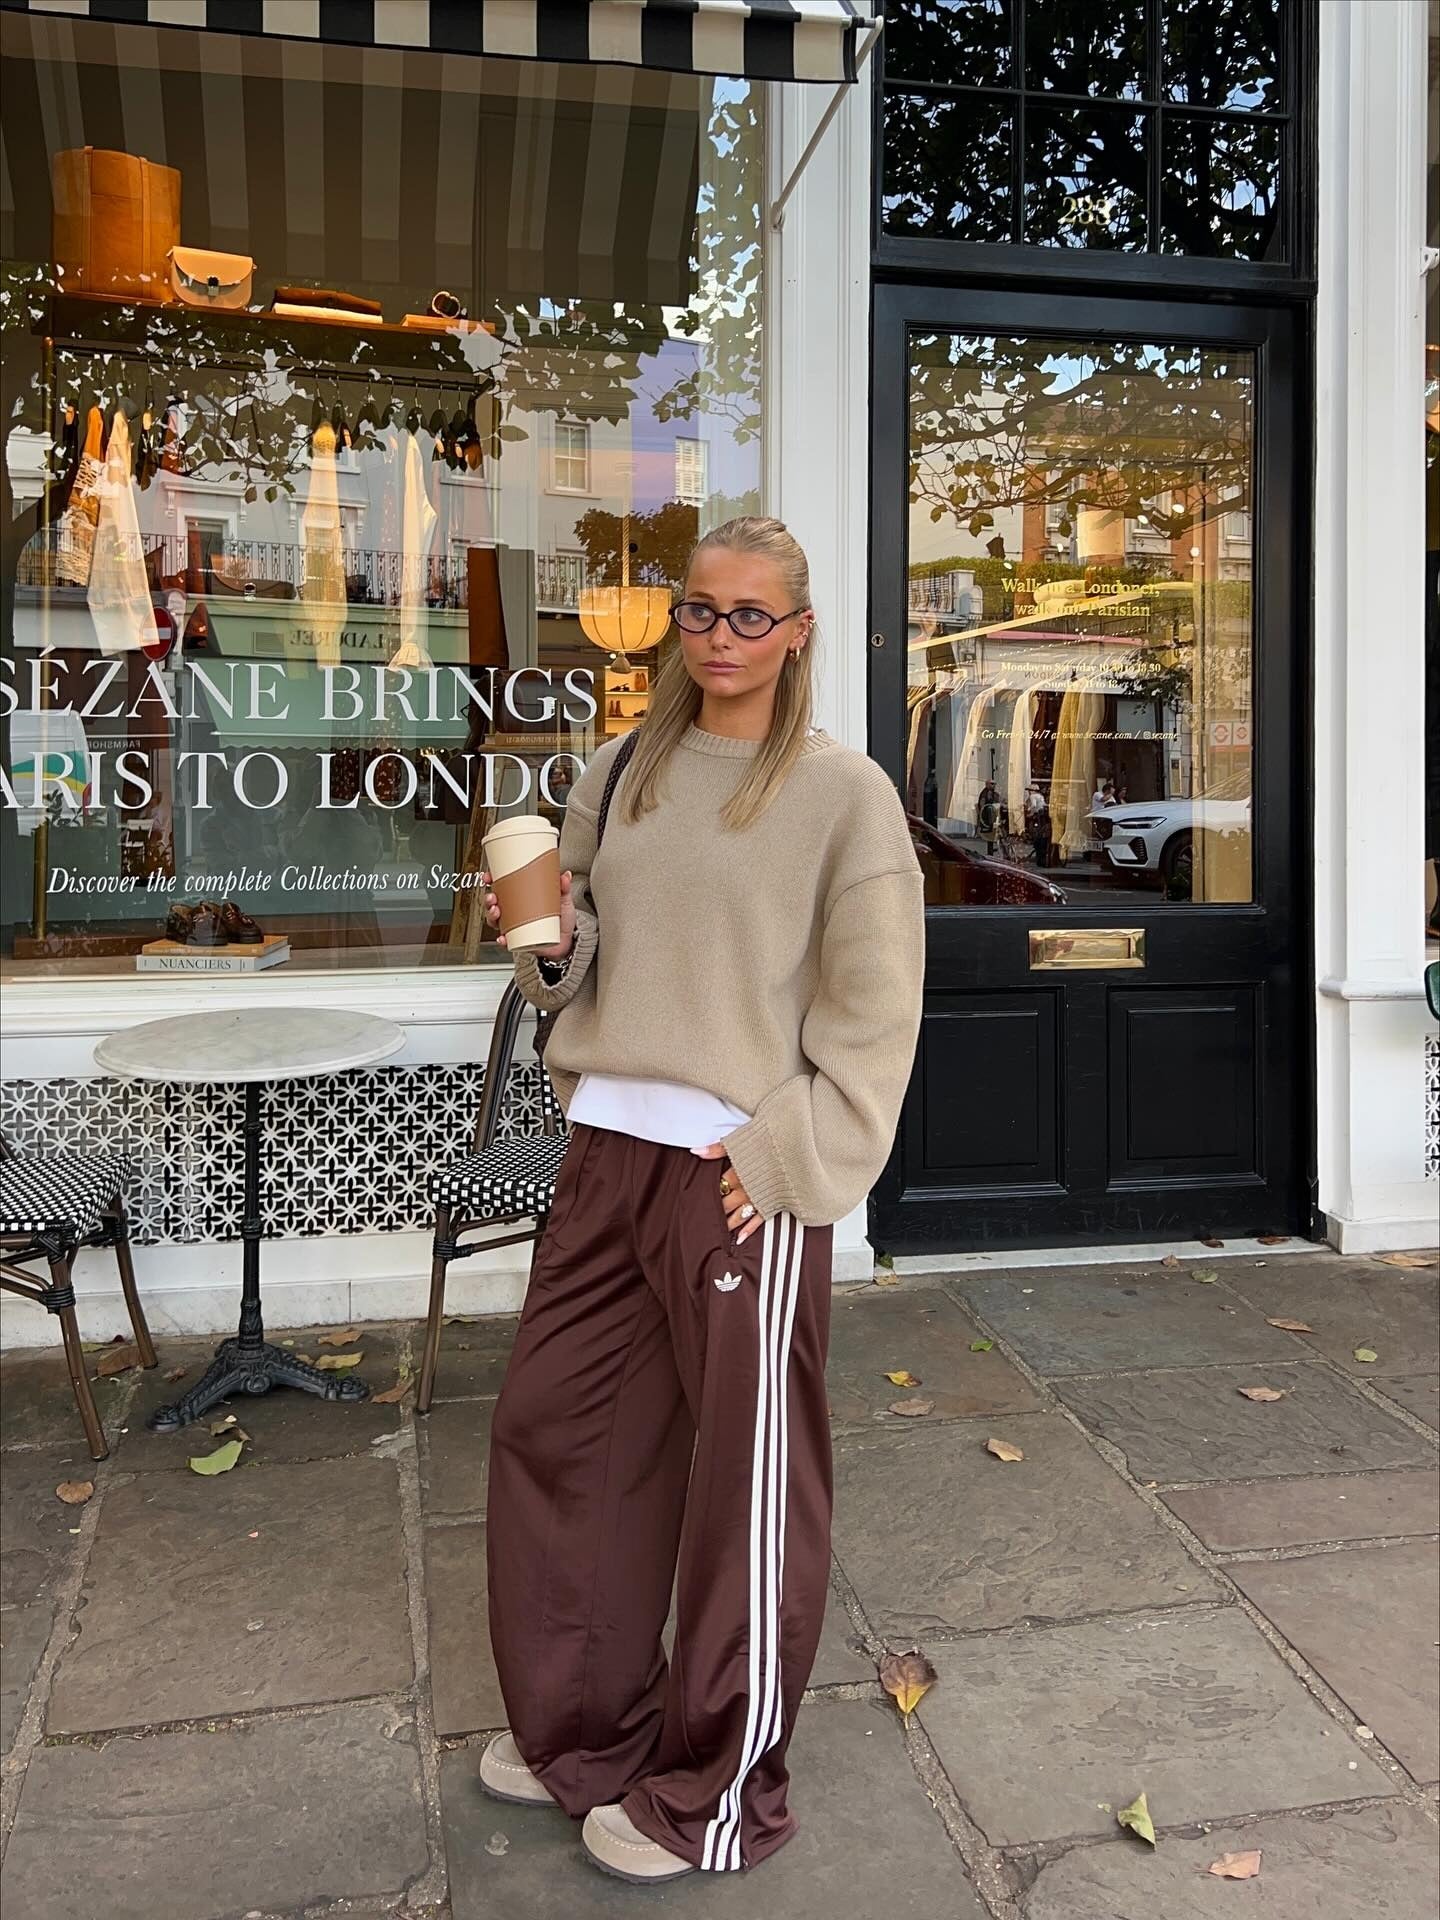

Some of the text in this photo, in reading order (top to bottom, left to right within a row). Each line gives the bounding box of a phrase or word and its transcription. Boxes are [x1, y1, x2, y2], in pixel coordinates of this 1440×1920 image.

[1001, 578, 1041, 593] Walk
[1065, 583, 1075, 593] a
[1079, 579, 1160, 597] Londoner,
[1087, 602, 1151, 617] Parisian
[1001, 662, 1036, 673] Monday
[1042, 663, 1052, 672] to
[319, 665, 598, 723] BRINGS
[981, 729, 995, 739] Go
[996, 729, 1025, 739] Fren
[1028, 729, 1051, 740] 24/7
[177, 752, 289, 810] TO
[46, 864, 491, 899] Discover the complete Collections on Sezan
[159, 957, 231, 970] NUANCIERS
